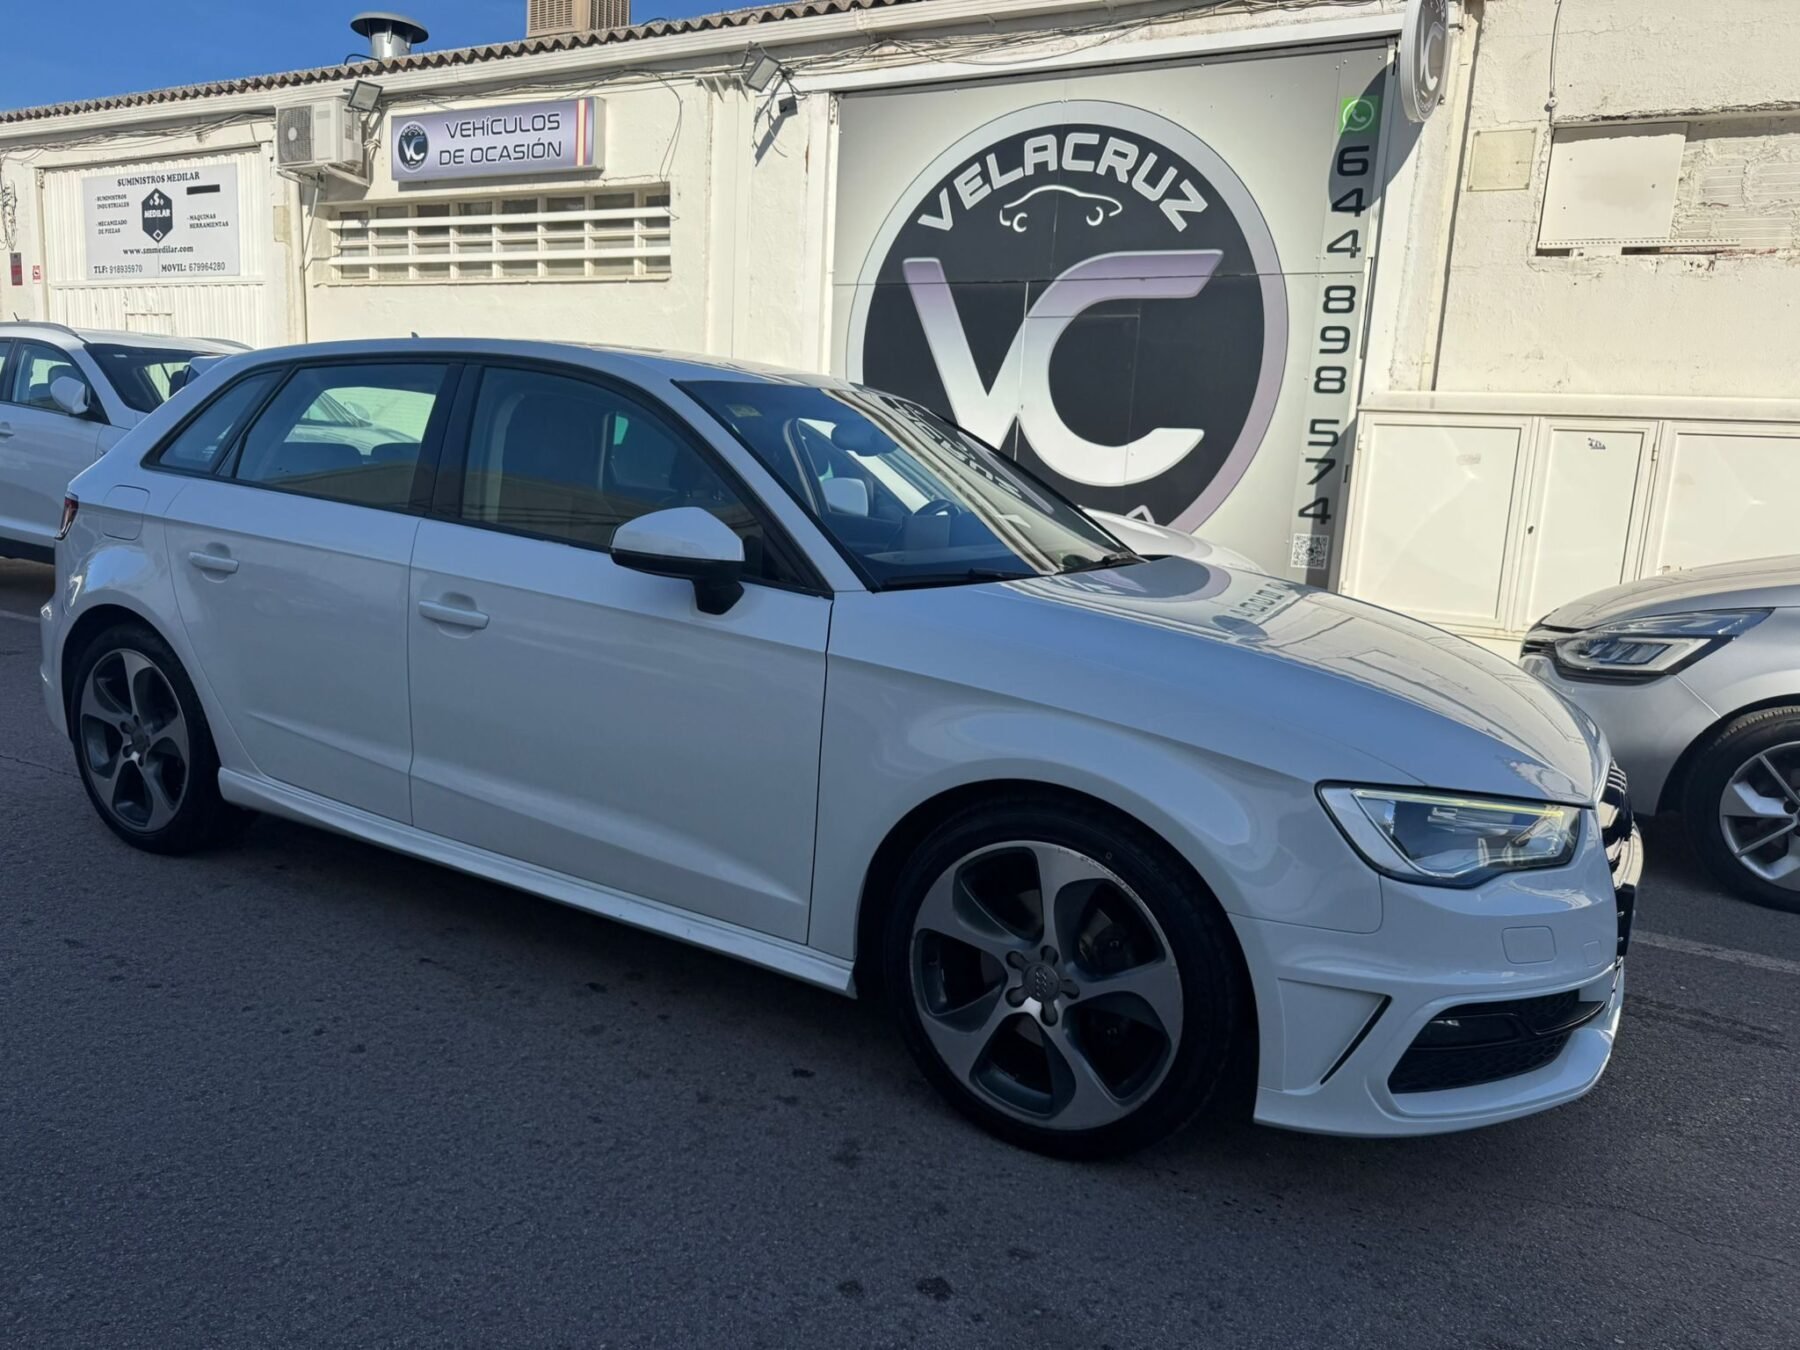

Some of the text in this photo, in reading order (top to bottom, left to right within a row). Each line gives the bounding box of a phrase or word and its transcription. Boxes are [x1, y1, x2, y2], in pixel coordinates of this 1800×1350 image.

[439, 138, 562, 166] DE OCASIÓN
[117, 171, 200, 187] SUMINISTROS MEDILAR
[917, 132, 1208, 232] VELACRUZ
[144, 209, 171, 218] MEDILAR
[189, 213, 216, 221] MAQUINAS
[98, 219, 127, 227] MECANIZADO
[189, 221, 229, 229] HERRAMIENTAS
[94, 265, 108, 274] TLF:
[161, 263, 187, 272] MOVIL:
[903, 249, 1224, 488] VC
